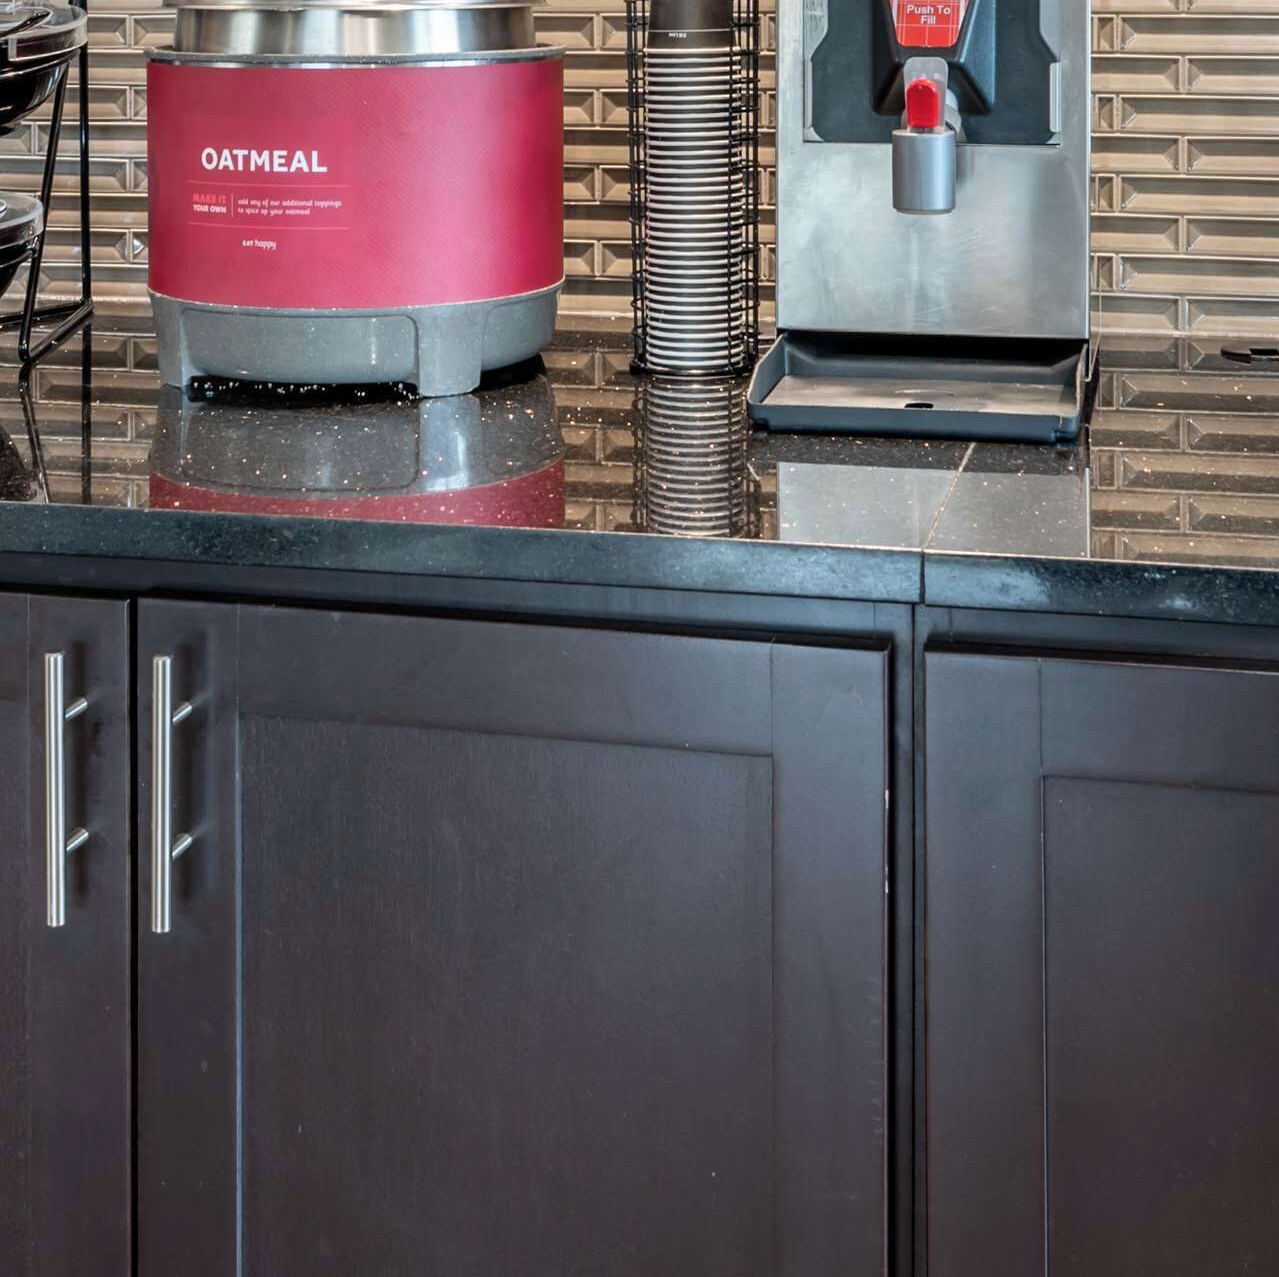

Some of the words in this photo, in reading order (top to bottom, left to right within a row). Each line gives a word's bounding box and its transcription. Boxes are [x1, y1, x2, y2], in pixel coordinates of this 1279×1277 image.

[907, 4, 934, 14] Push
[937, 5, 951, 15] To
[921, 15, 936, 24] Fill
[201, 147, 328, 173] OATMEAL
[193, 204, 209, 212] YOUR
[209, 205, 227, 213] OWN
[314, 200, 342, 209] toppings
[255, 239, 276, 250] happy
